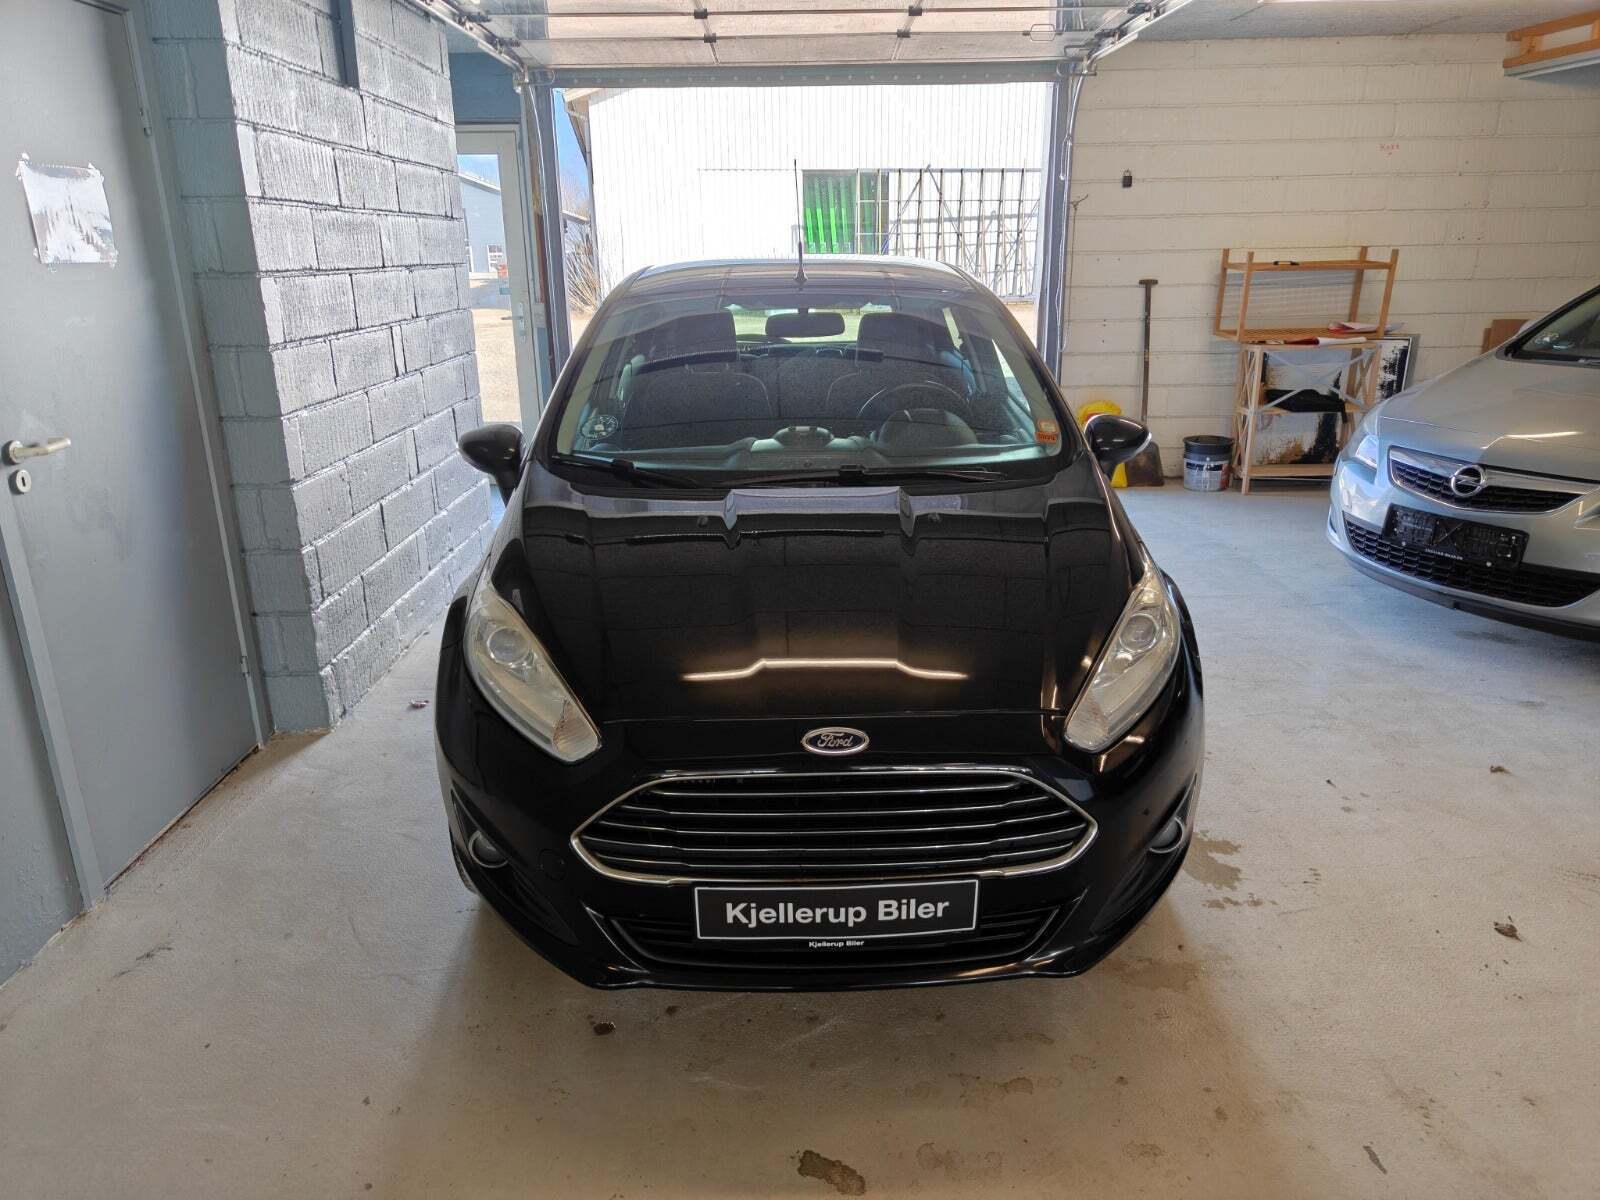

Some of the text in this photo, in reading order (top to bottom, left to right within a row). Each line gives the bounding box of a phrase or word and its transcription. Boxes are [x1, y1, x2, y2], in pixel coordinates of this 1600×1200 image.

[817, 732, 853, 747] Ford
[725, 898, 950, 929] Kjellerup Biler
